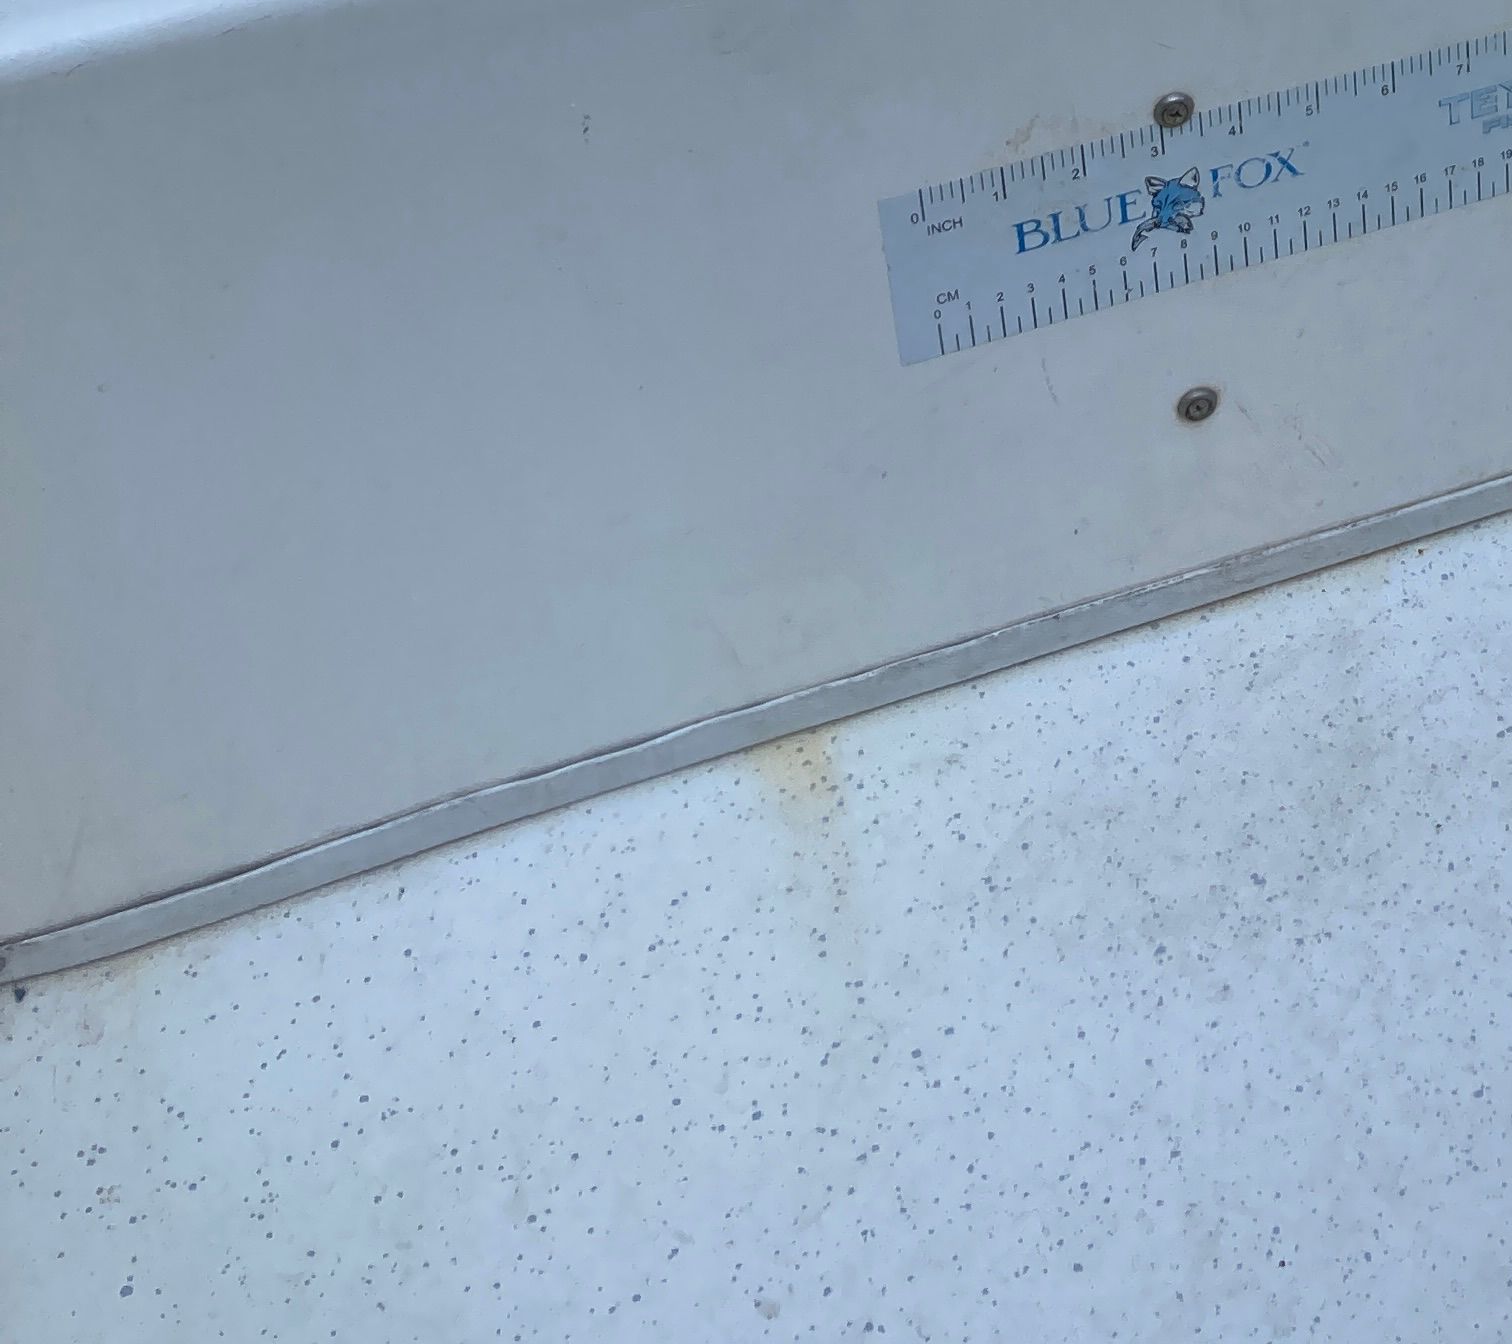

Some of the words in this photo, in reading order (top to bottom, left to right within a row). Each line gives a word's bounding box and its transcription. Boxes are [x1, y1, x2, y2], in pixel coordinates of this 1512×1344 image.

[910, 212, 920, 225] 0
[992, 191, 999, 202] 1
[1071, 167, 1080, 181] 2
[1150, 146, 1159, 158] 3
[1228, 125, 1237, 136] 4
[1305, 104, 1314, 117] 5
[1380, 84, 1390, 97] 6
[1456, 63, 1464, 76] 7
[926, 216, 964, 236] INCH
[933, 309, 942, 320] 0
[996, 291, 1004, 303] 2
[1058, 274, 1066, 284] 4
[1119, 256, 1127, 266] 6
[1180, 239, 1188, 249] 8
[1238, 222, 1251, 233] 10
[1297, 205, 1311, 217] 12
[1356, 190, 1368, 201] 14
[1414, 173, 1427, 184] 16
[1472, 157, 1485, 168] 18
[1011, 189, 1148, 255] BLUE
[1209, 147, 1305, 198] FOX
[935, 289, 960, 305] CM
